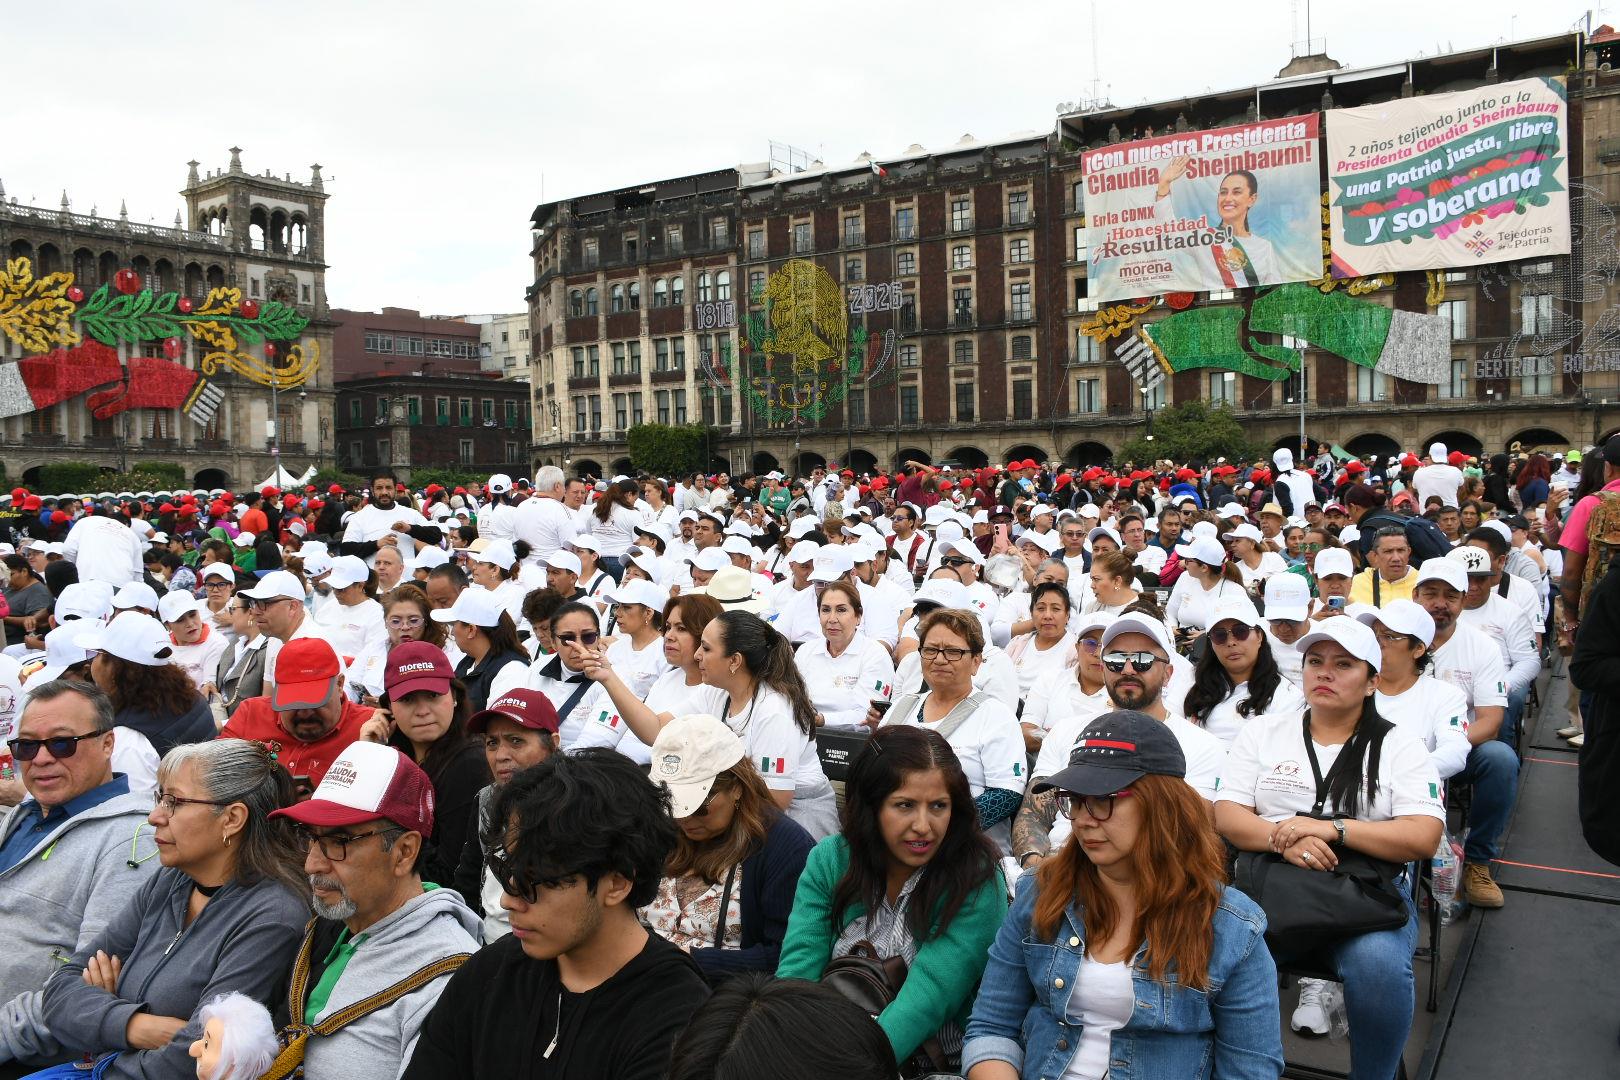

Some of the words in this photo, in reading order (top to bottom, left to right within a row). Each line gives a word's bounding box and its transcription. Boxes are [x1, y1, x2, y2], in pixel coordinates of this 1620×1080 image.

[1336, 147, 1413, 172] Presidenta
[1416, 122, 1468, 152] Claudia
[1472, 102, 1559, 129] Sheinbaum
[1347, 145, 1357, 158] 2
[1361, 139, 1394, 156] años
[1398, 114, 1454, 146] tejiendo
[1457, 97, 1496, 123] junto
[1501, 95, 1511, 105] a
[1517, 91, 1531, 103] la
[1086, 151, 1126, 174] ¡Con
[1128, 136, 1199, 165] nuestra
[1201, 121, 1307, 155] Presidenta
[1087, 166, 1160, 195] Claudia
[1185, 140, 1312, 180] Sheinbaum!
[1345, 178, 1382, 198] una
[1386, 156, 1442, 189] Patria
[1446, 133, 1502, 170] justa,
[1092, 214, 1106, 227] En
[1106, 212, 1118, 224] la
[1121, 205, 1155, 223] CDMX
[1364, 216, 1388, 244] y
[1392, 165, 1542, 233] soberana
[1102, 225, 1233, 259] Resultados!
[1106, 215, 1208, 244] ¡Honestidad
[1497, 226, 1553, 243] Tejedoras
[1514, 235, 1549, 249] Patria
[1119, 261, 1173, 278] morena
[695, 301, 738, 330] 1810
[398, 661, 435, 673] morena
